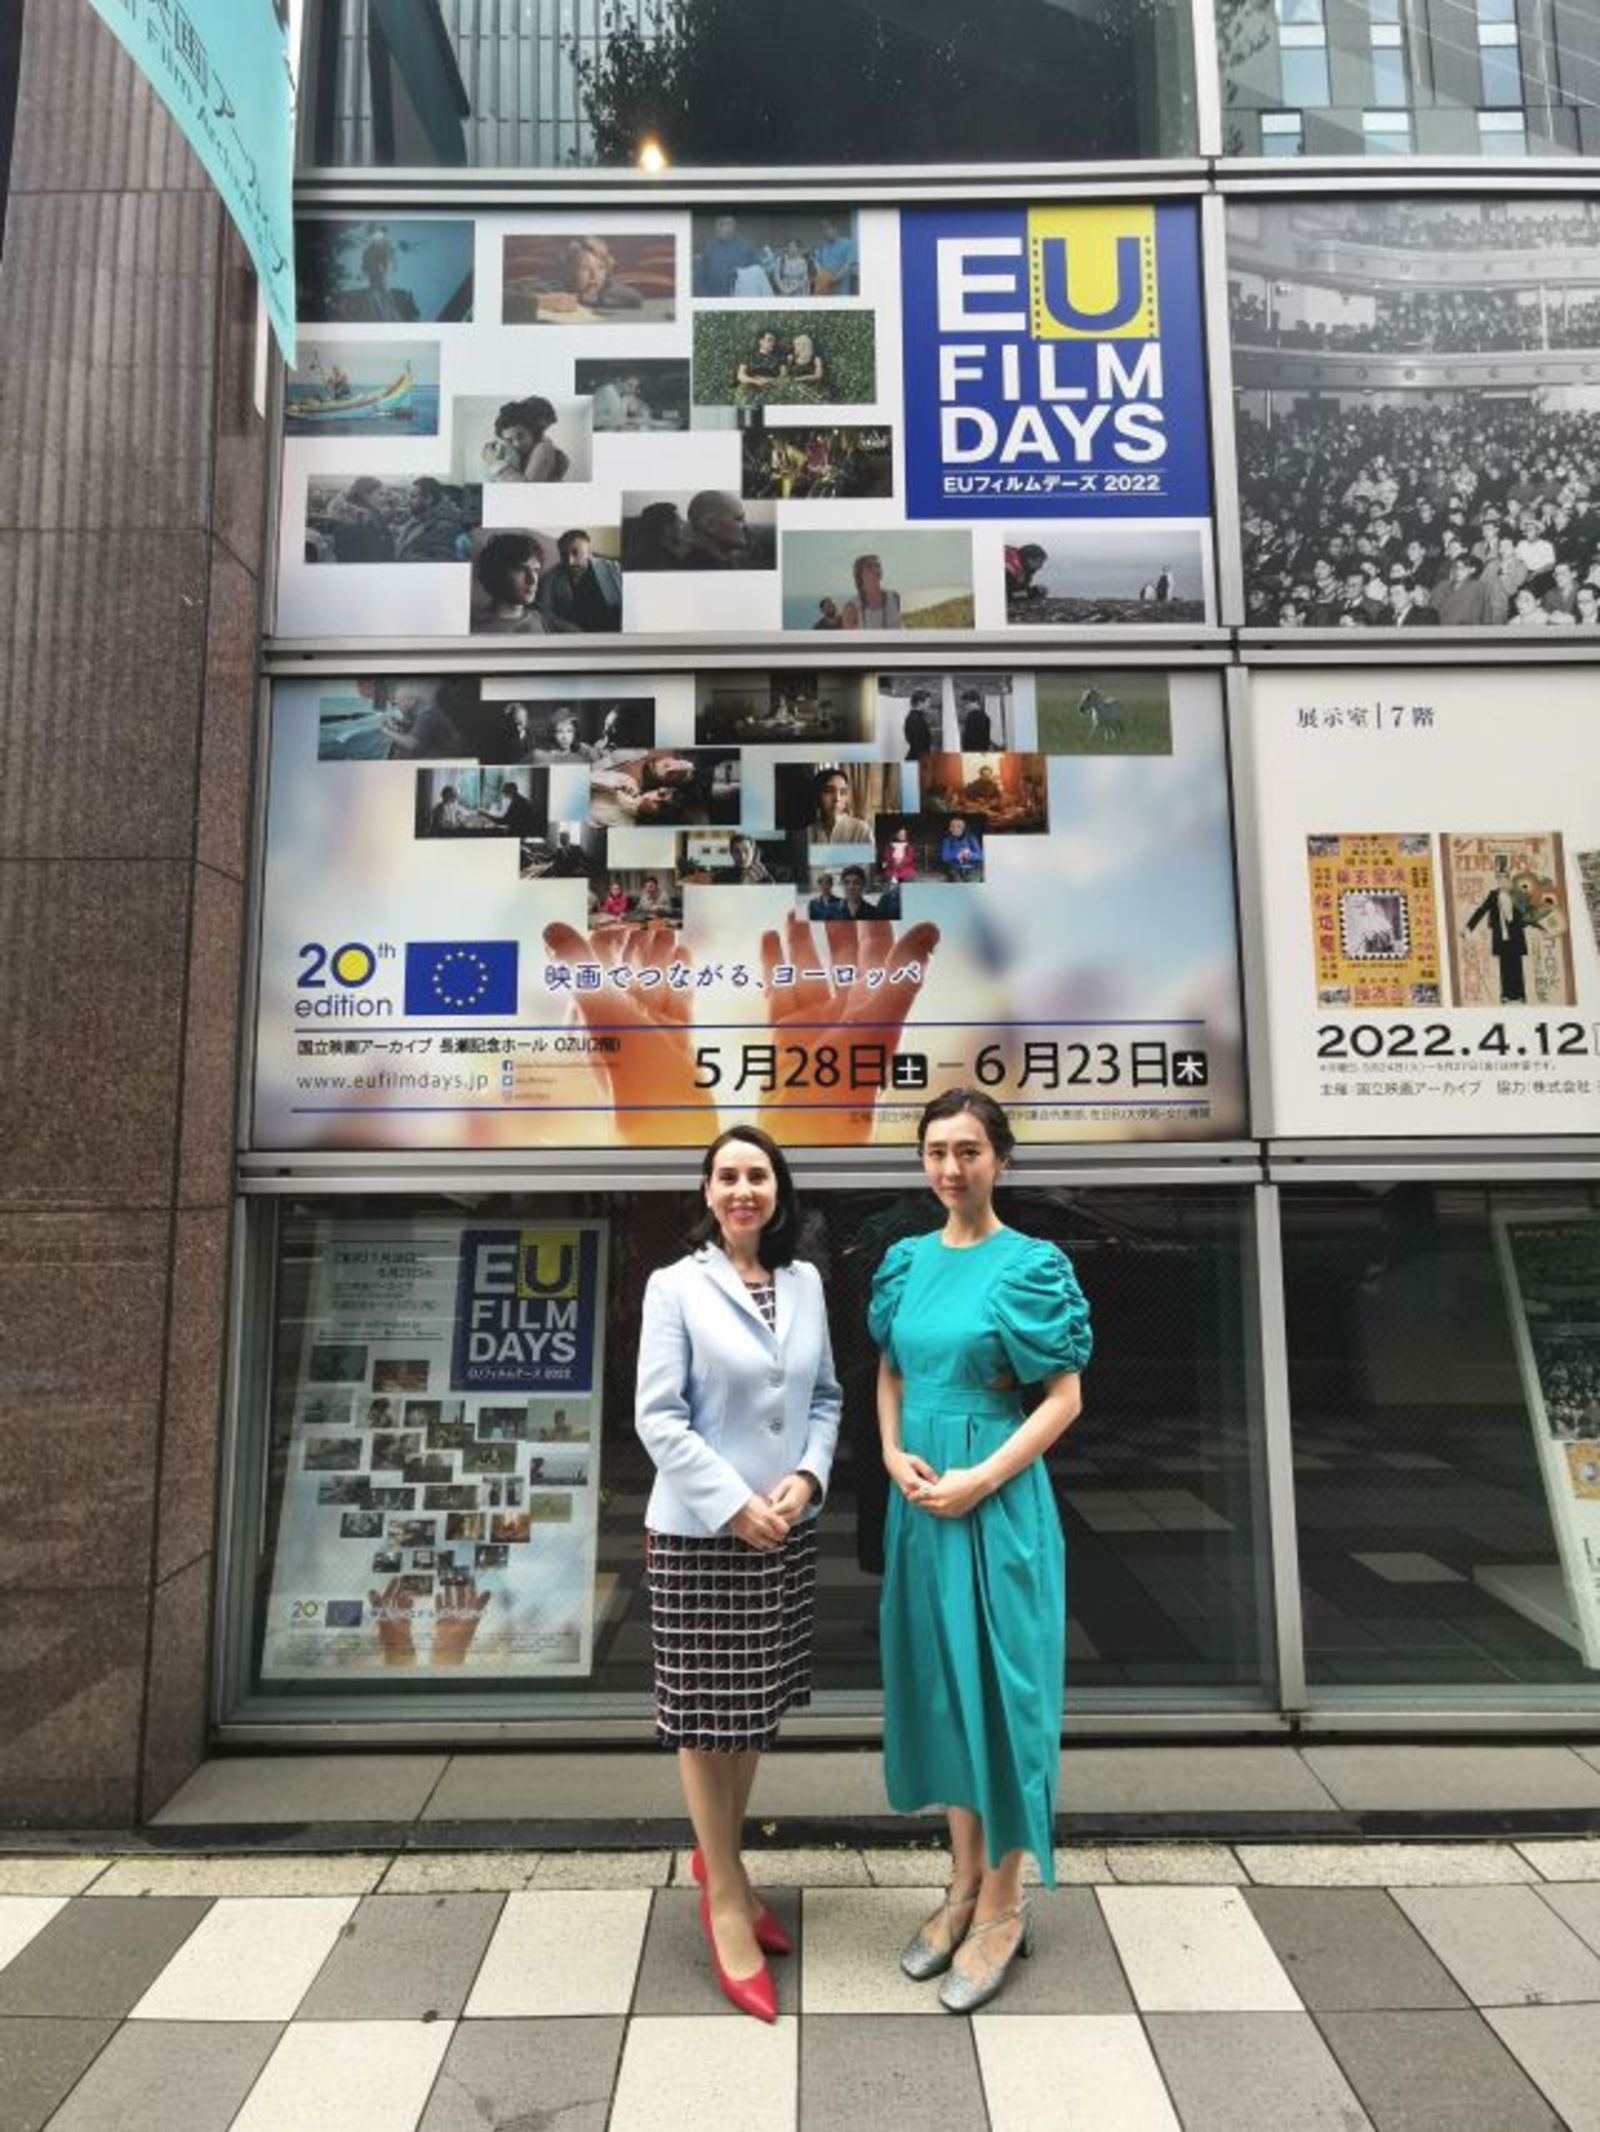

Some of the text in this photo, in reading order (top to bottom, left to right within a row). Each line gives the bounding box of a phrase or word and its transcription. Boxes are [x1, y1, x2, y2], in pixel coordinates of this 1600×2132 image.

[937, 236, 1142, 332] EU
[940, 342, 1164, 401] FILM
[942, 403, 1168, 463] DAYS
[943, 474, 1161, 493] EUフィルムデーズ 2022
[295, 994, 394, 1018] edition
[1317, 1022, 1588, 1058] 2022.4.12
[296, 1071, 488, 1091] www.eufilmdays.jp
[475, 1244, 573, 1294] EU
[471, 1300, 578, 1329] FILM
[469, 1332, 577, 1364] DAYS
